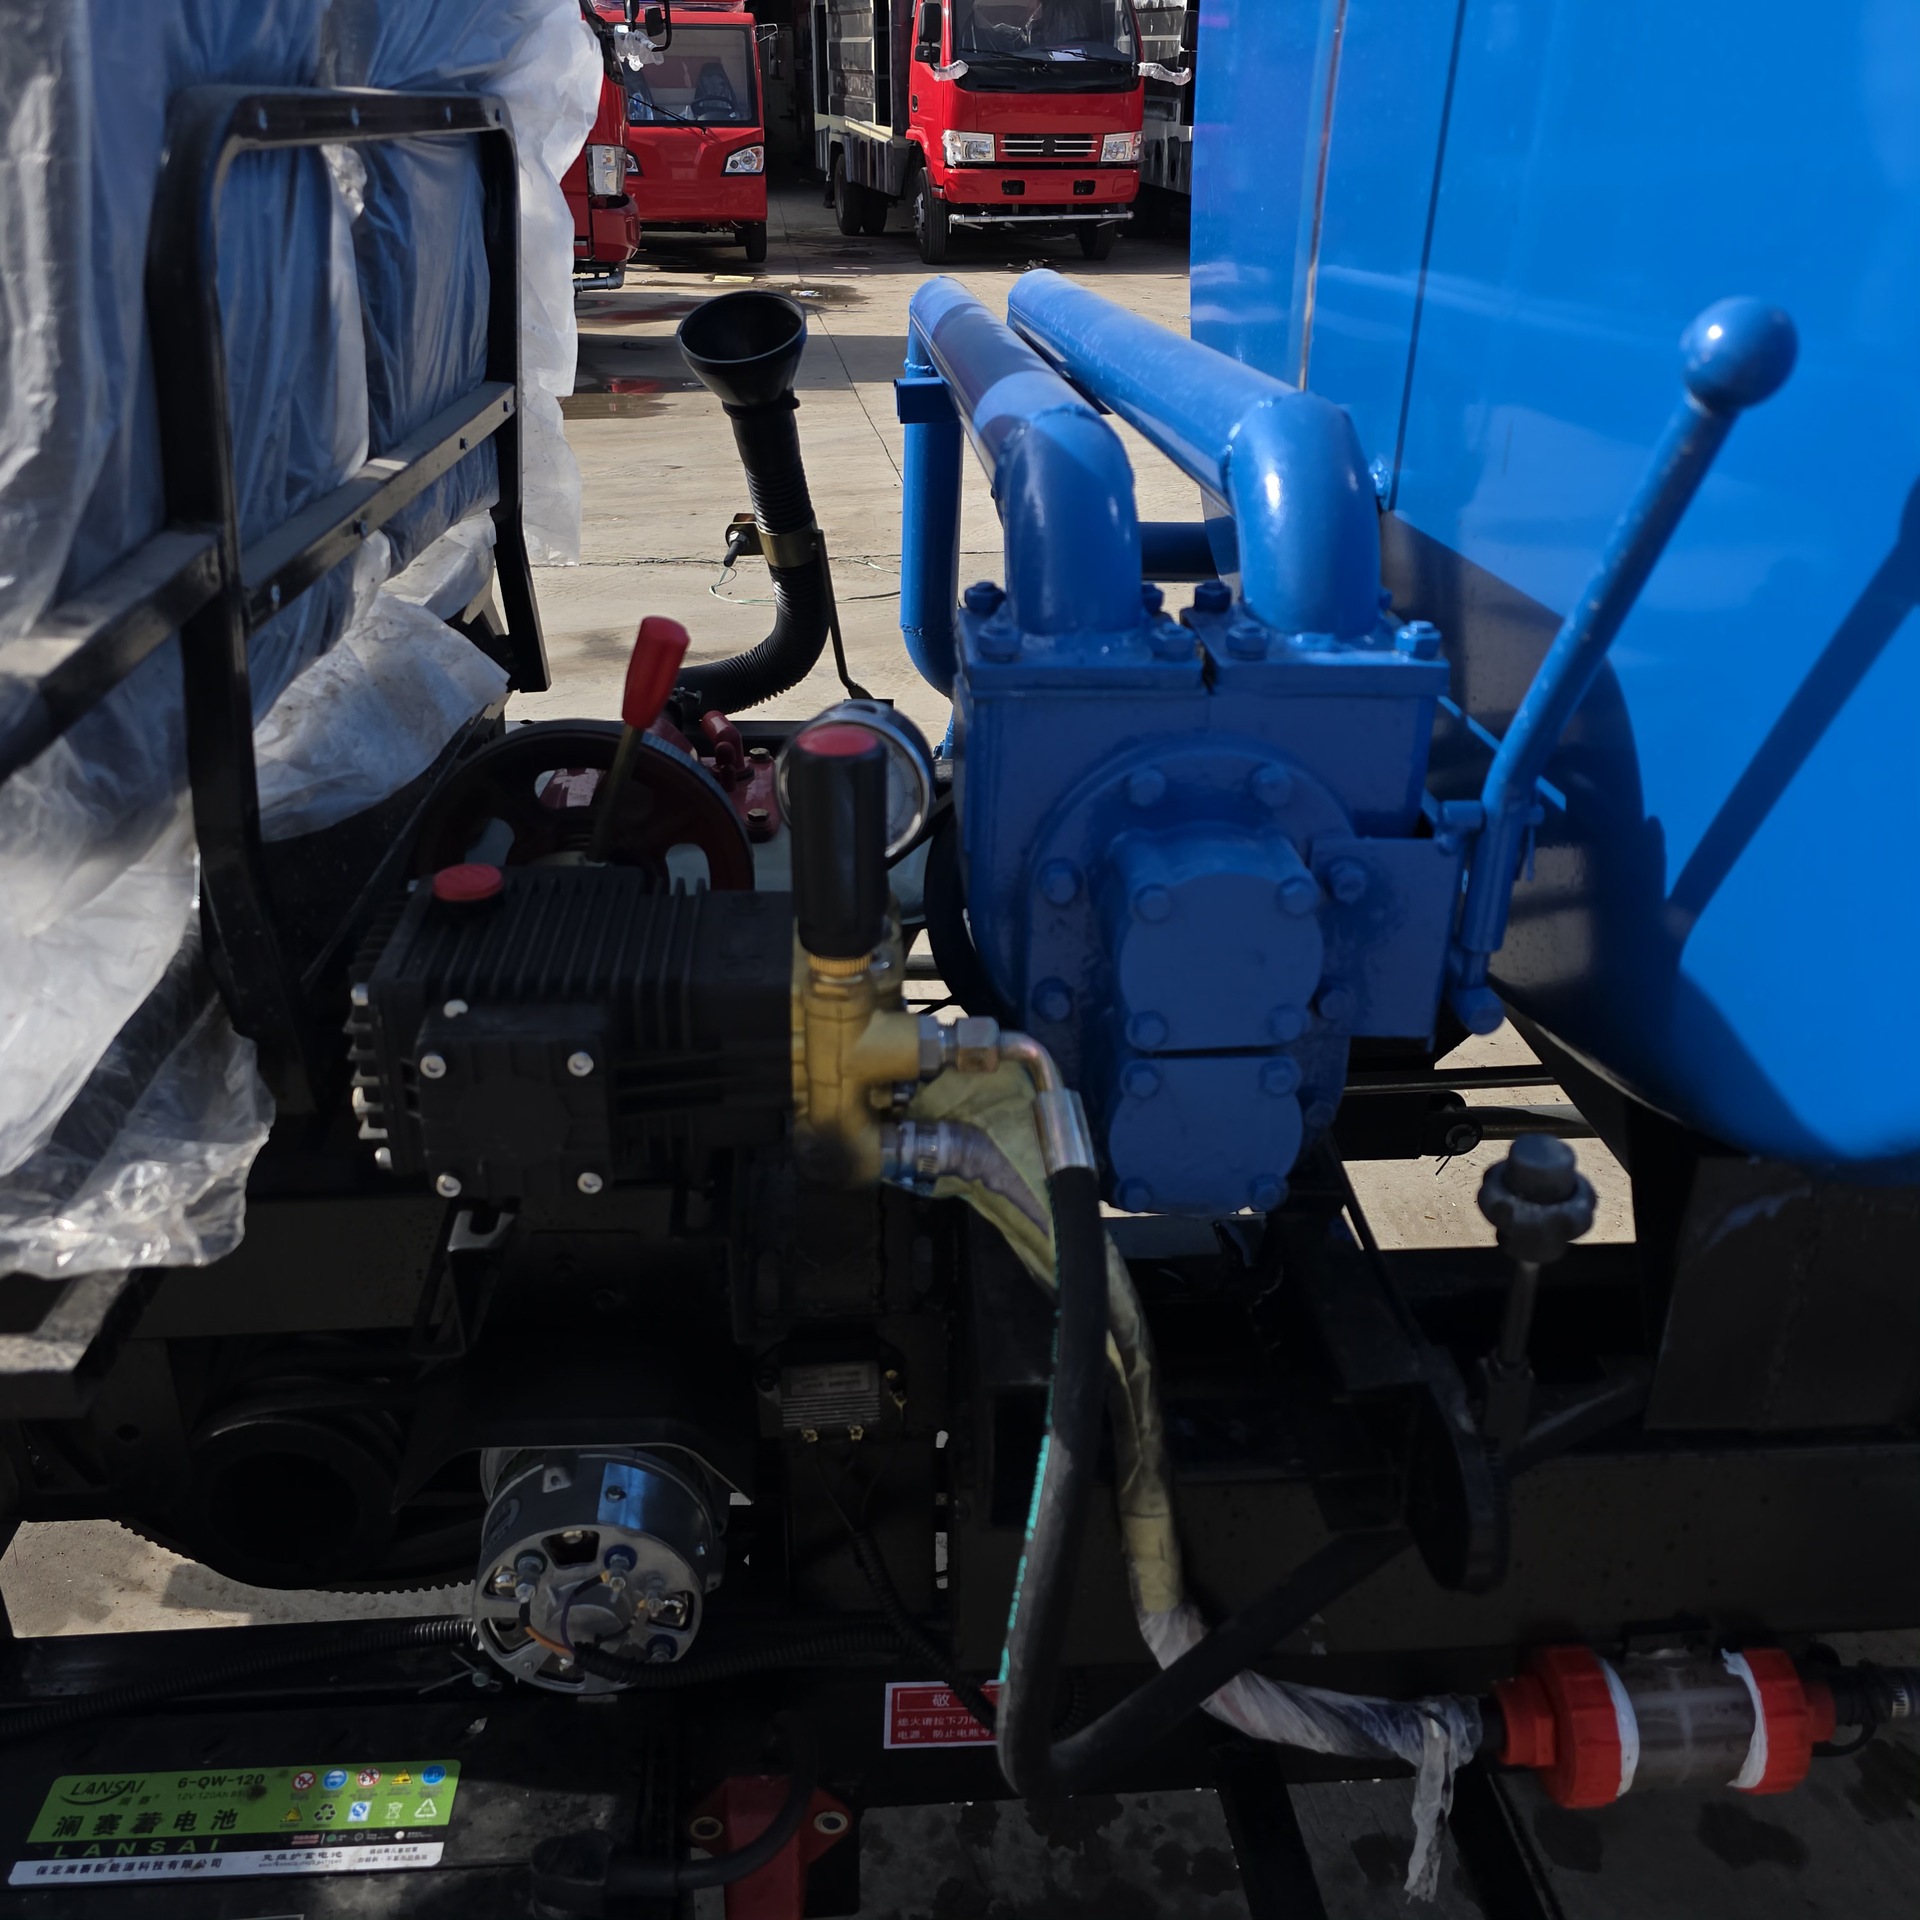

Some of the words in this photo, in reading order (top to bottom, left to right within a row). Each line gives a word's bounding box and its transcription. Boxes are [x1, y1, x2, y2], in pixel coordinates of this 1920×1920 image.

[70, 1779, 146, 1797] LANSAI
[177, 1773, 266, 1789] 6-QW-120
[52, 1808, 238, 1837] 澜赛蓄电池
[54, 1838, 218, 1858] LANSAI
